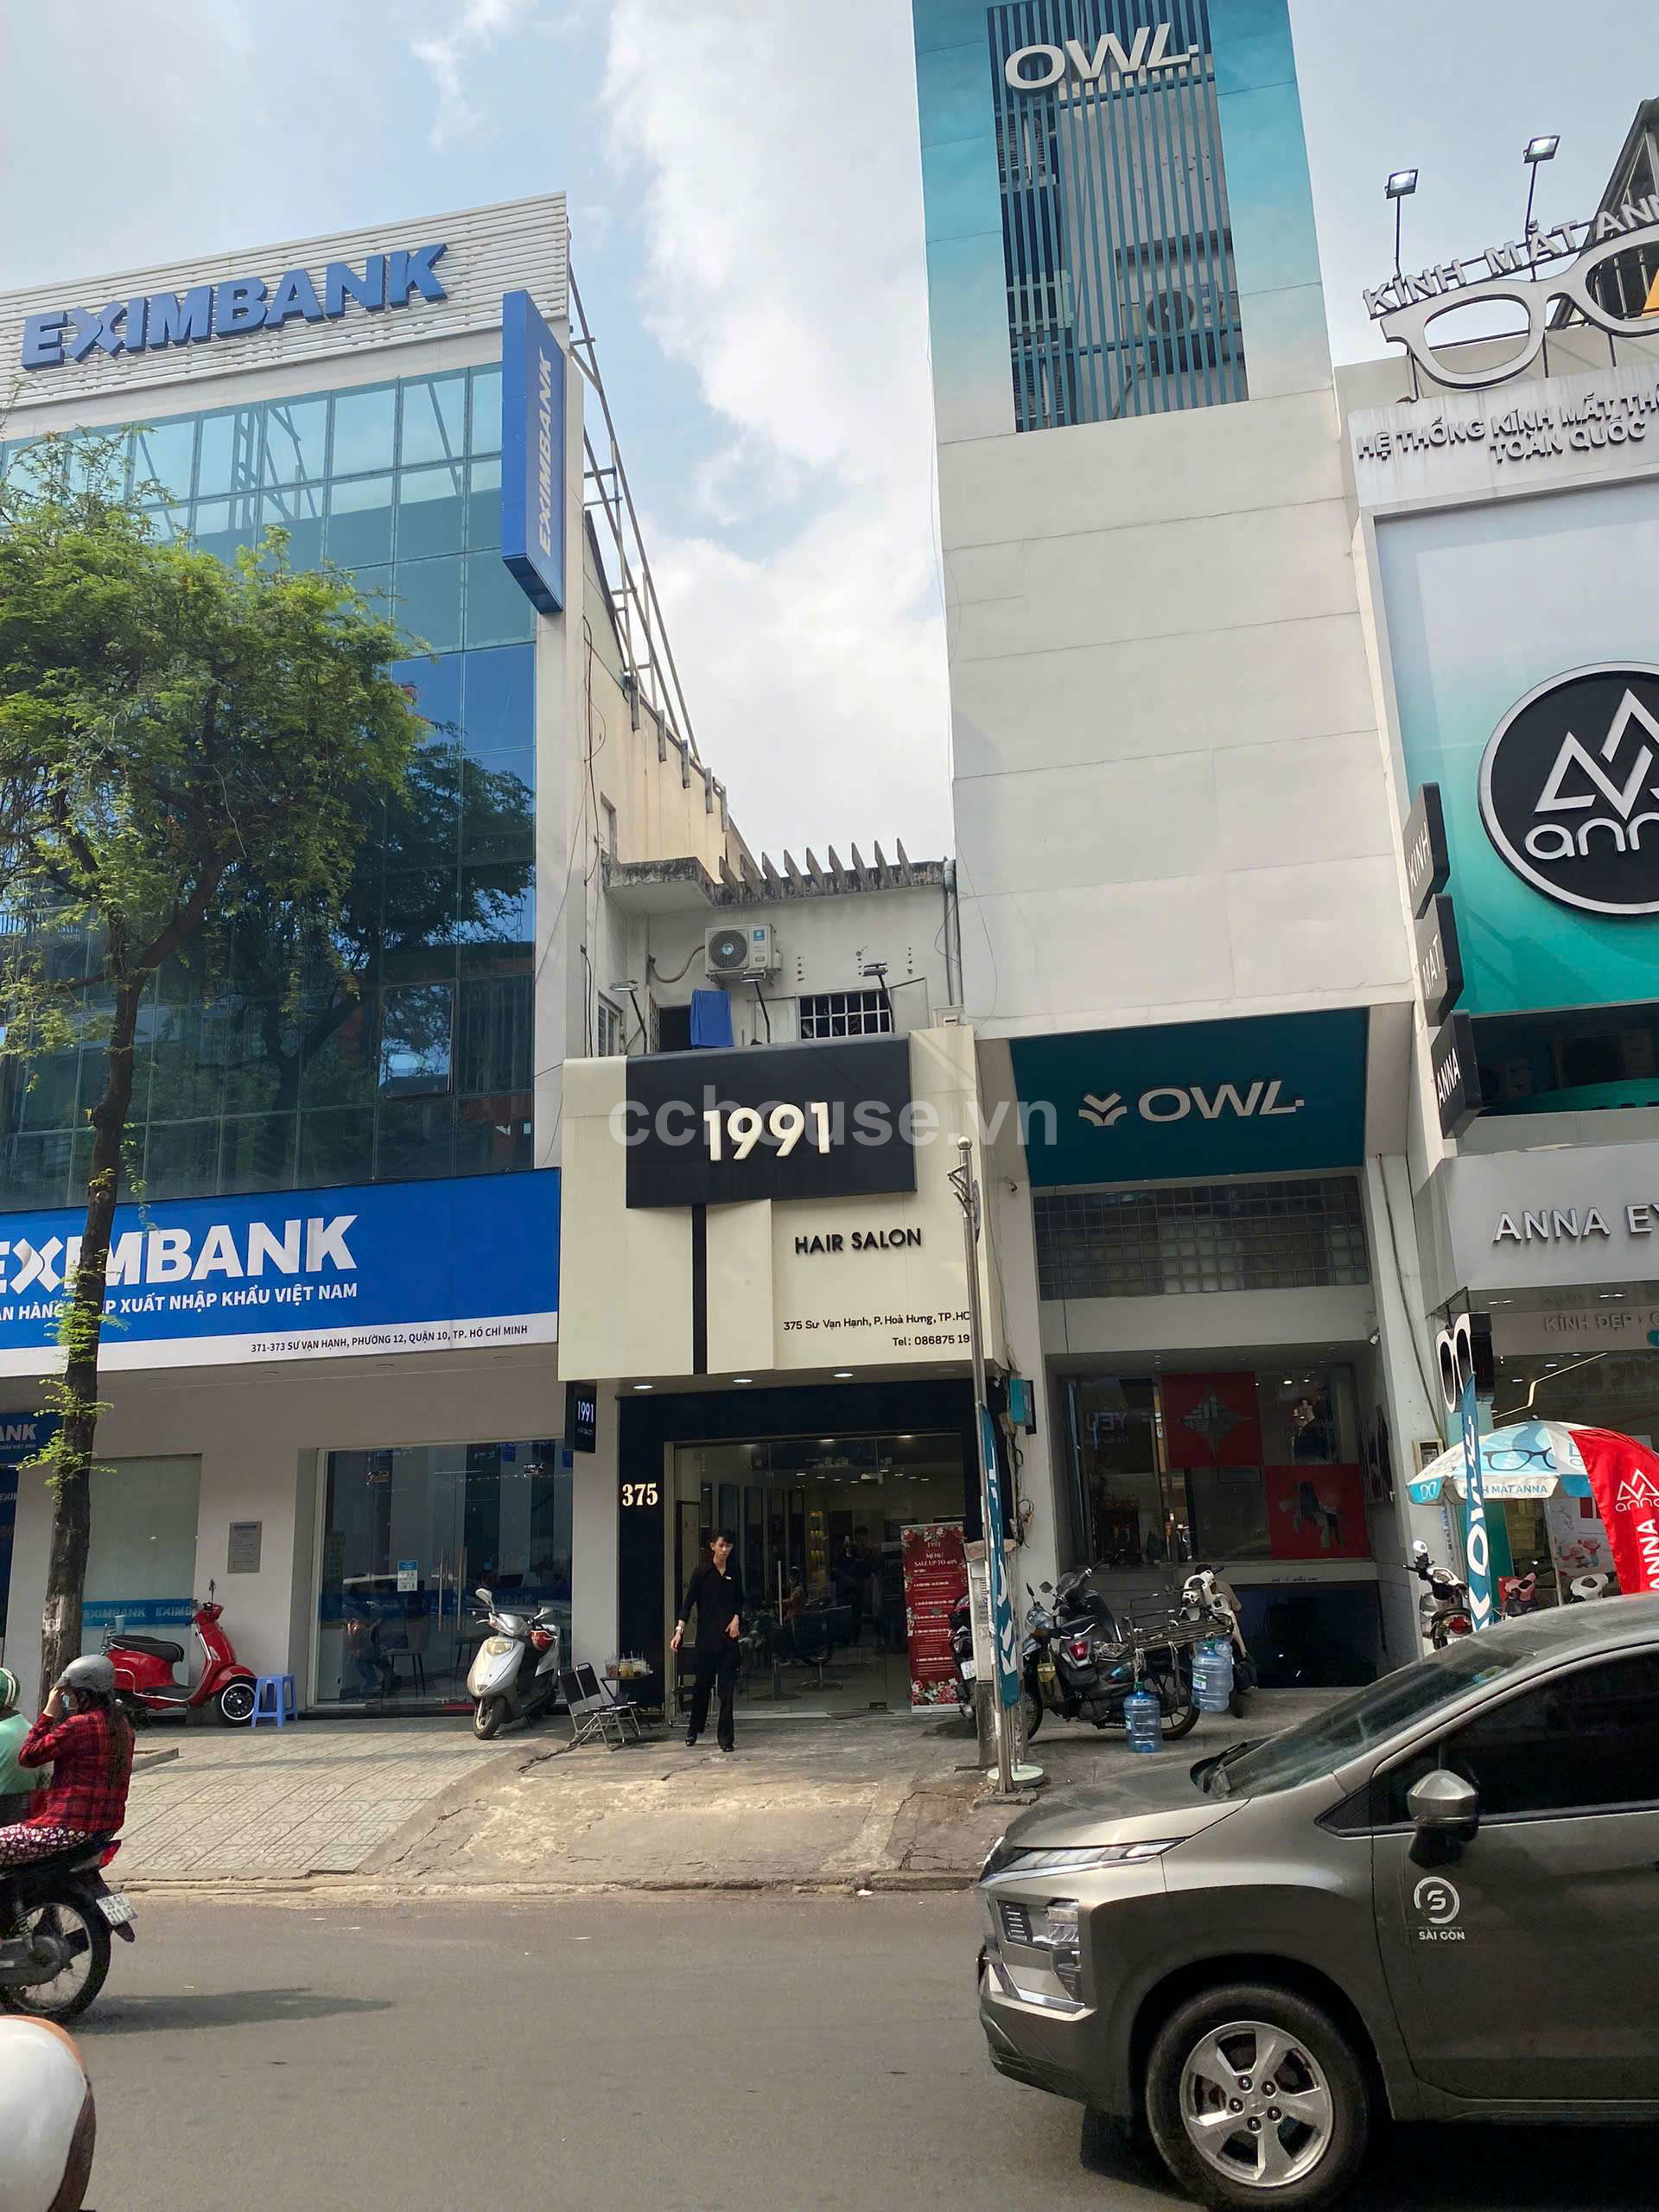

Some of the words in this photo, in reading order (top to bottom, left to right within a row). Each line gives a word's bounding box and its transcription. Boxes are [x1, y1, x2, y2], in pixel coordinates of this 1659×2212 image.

[1363, 259, 1467, 317] KÍNH
[1484, 219, 1578, 276] MẮT
[21, 243, 448, 371] EXIMBANK
[1357, 432, 1391, 461] HỆ
[1395, 415, 1486, 453] THỐNG
[1491, 408, 1554, 439] KÍNH
[1559, 391, 1615, 428] MẮT
[1620, 384, 1659, 417] TH
[538, 346, 551, 558] EXIMBANK
[1489, 430, 1564, 463] TOÀN
[1569, 415, 1646, 451] QUỐC
[1437, 1046, 1462, 1109] ANNA
[702, 1101, 831, 1161] 1991
[1493, 1206, 1611, 1243] ANNA
[795, 1234, 844, 1255] HAIR
[851, 1228, 921, 1250] SALON
[120, 1292, 166, 1314] XUẤT
[169, 1289, 217, 1313] NHẬP
[221, 1284, 270, 1306] KHẨU
[275, 1283, 314, 1306] VIỆT
[318, 1283, 358, 1300] NAM
[783, 1319, 803, 1331] 375
[805, 1319, 820, 1330] Sư
[823, 1319, 842, 1331] Vạn
[843, 1317, 872, 1329] Hạnh,
[874, 1316, 883, 1325] P.
[906, 1313, 937, 1325] Hưng,
[1543, 1311, 1588, 1332] KÍNH
[251, 1342, 285, 1353] 371-373
[302, 1340, 319, 1351] VẠN
[321, 1338, 350, 1351] HẠNH,
[352, 1333, 391, 1345] PHƯỜNG
[393, 1334, 407, 1345] 12,
[409, 1330, 435, 1344] QUẬN
[437, 1332, 451, 1342] 10,
[453, 1330, 467, 1339] TP.
[503, 1325, 528, 1336] MINH
[892, 1337, 912, 1346] Tel:
[914, 1335, 955, 1345] 086875
[577, 1401, 594, 1423] 1991
[622, 1482, 658, 1507] 375
[1516, 1484, 1549, 1494] ANNA
